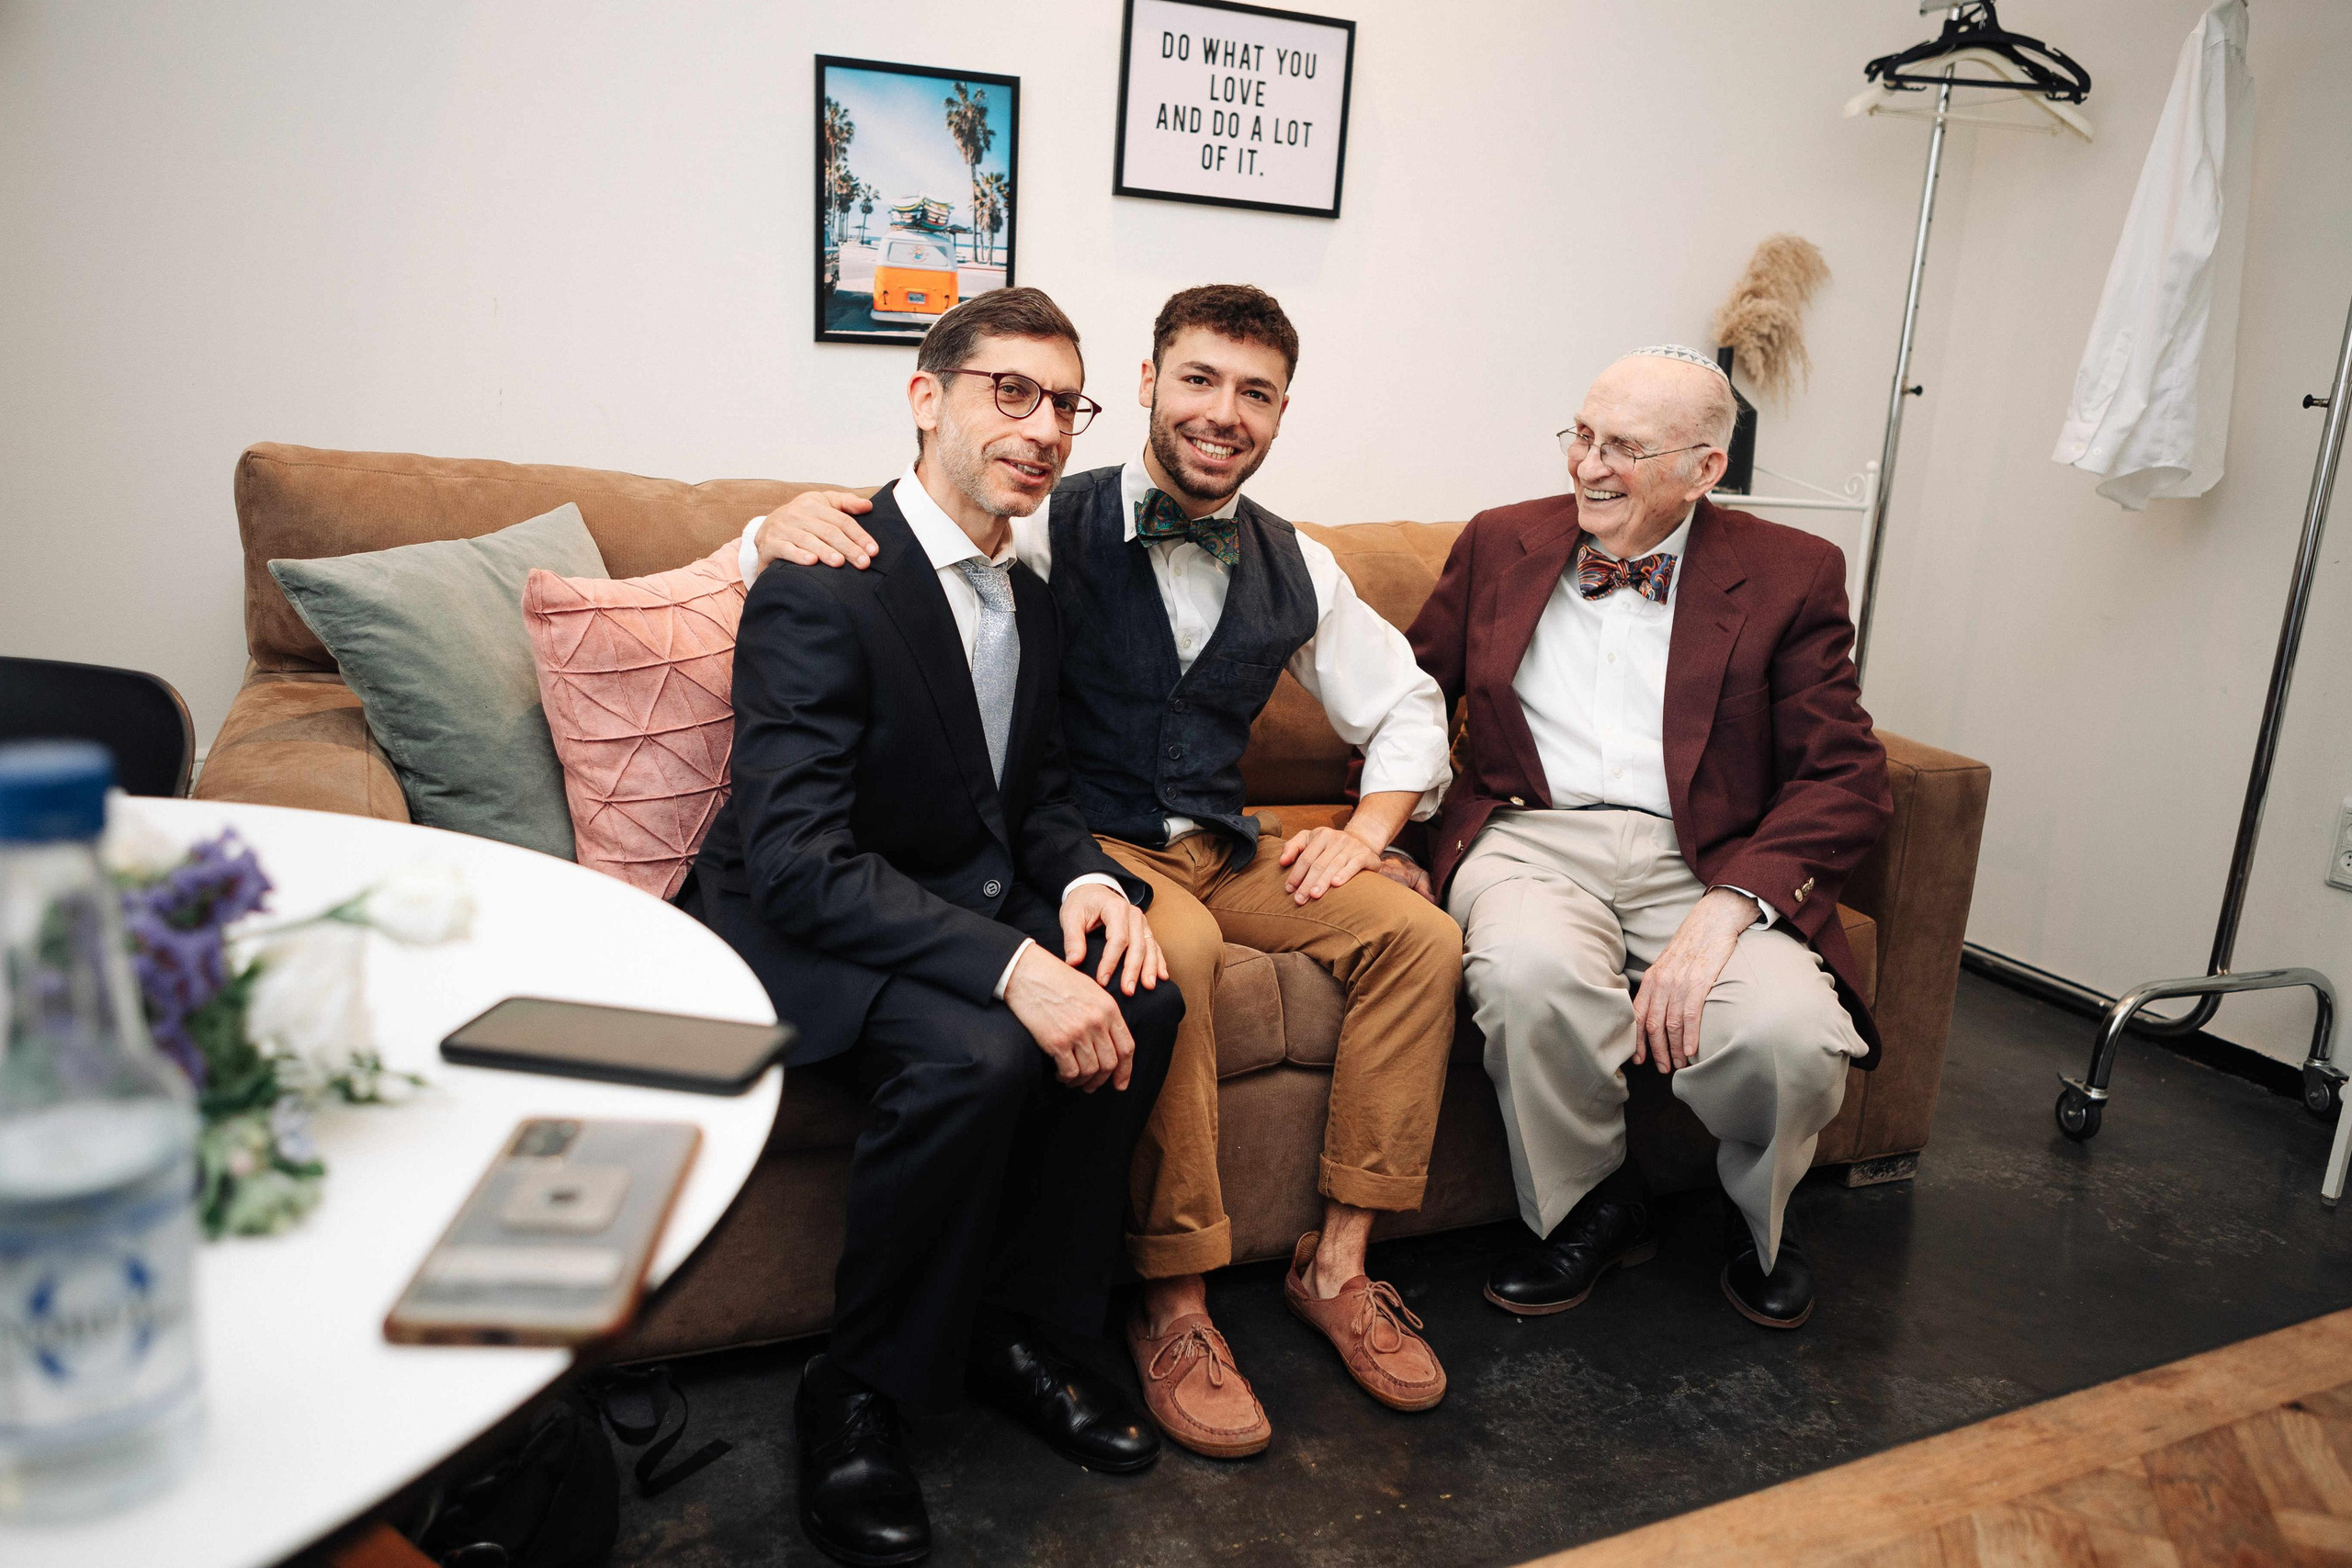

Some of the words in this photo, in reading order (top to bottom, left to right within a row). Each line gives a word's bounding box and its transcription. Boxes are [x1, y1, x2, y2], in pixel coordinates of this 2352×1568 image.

[1162, 31, 1191, 61] DO
[1204, 38, 1265, 71] WHAT
[1277, 49, 1317, 80] YOU
[1210, 74, 1267, 107] LOVE
[1156, 103, 1202, 133] AND
[1213, 110, 1240, 139] DO
[1250, 116, 1262, 141] A
[1274, 118, 1313, 147] LOT
[1202, 144, 1228, 172] OF
[1238, 148, 1264, 176] IT.
